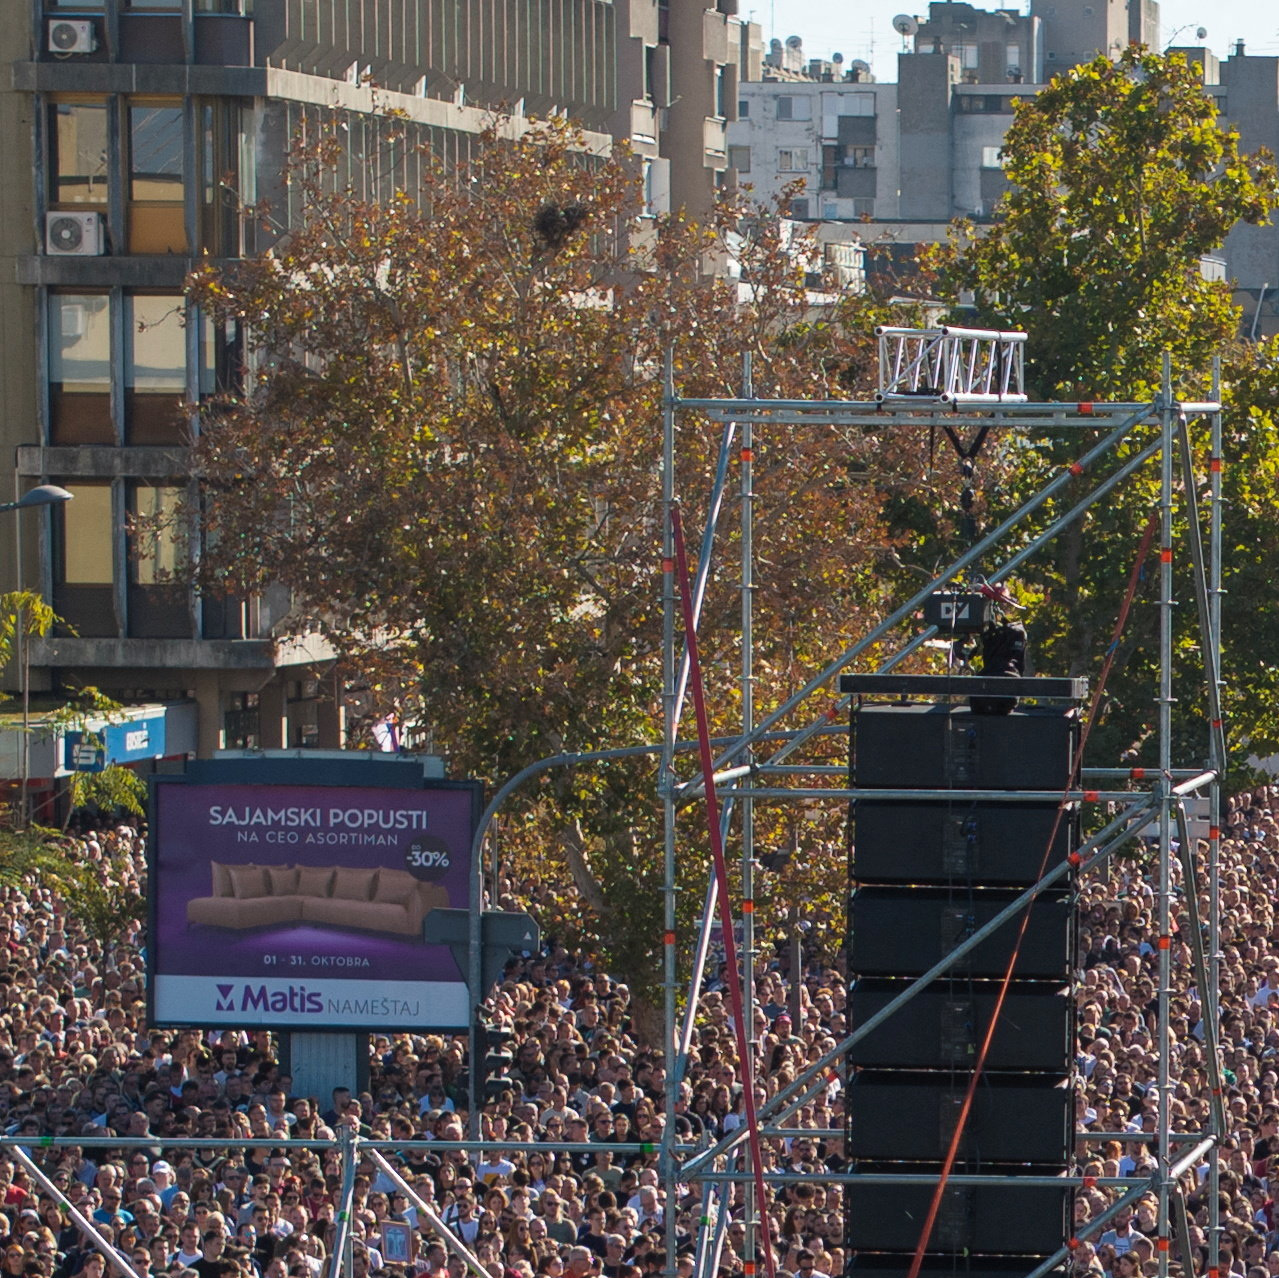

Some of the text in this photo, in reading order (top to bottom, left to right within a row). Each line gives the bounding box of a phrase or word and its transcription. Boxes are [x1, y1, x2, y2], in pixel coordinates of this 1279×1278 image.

[209, 806, 427, 829] SAJAMSKI POPUSTI
[237, 831, 398, 846] NA CEO ASORTIMAN
[406, 851, 450, 867] -30%
[264, 955, 276, 965] 01
[290, 955, 306, 966] 31.
[311, 955, 370, 967] OKTOBRA
[241, 985, 420, 1016] Matis NAMEŠTAJ
